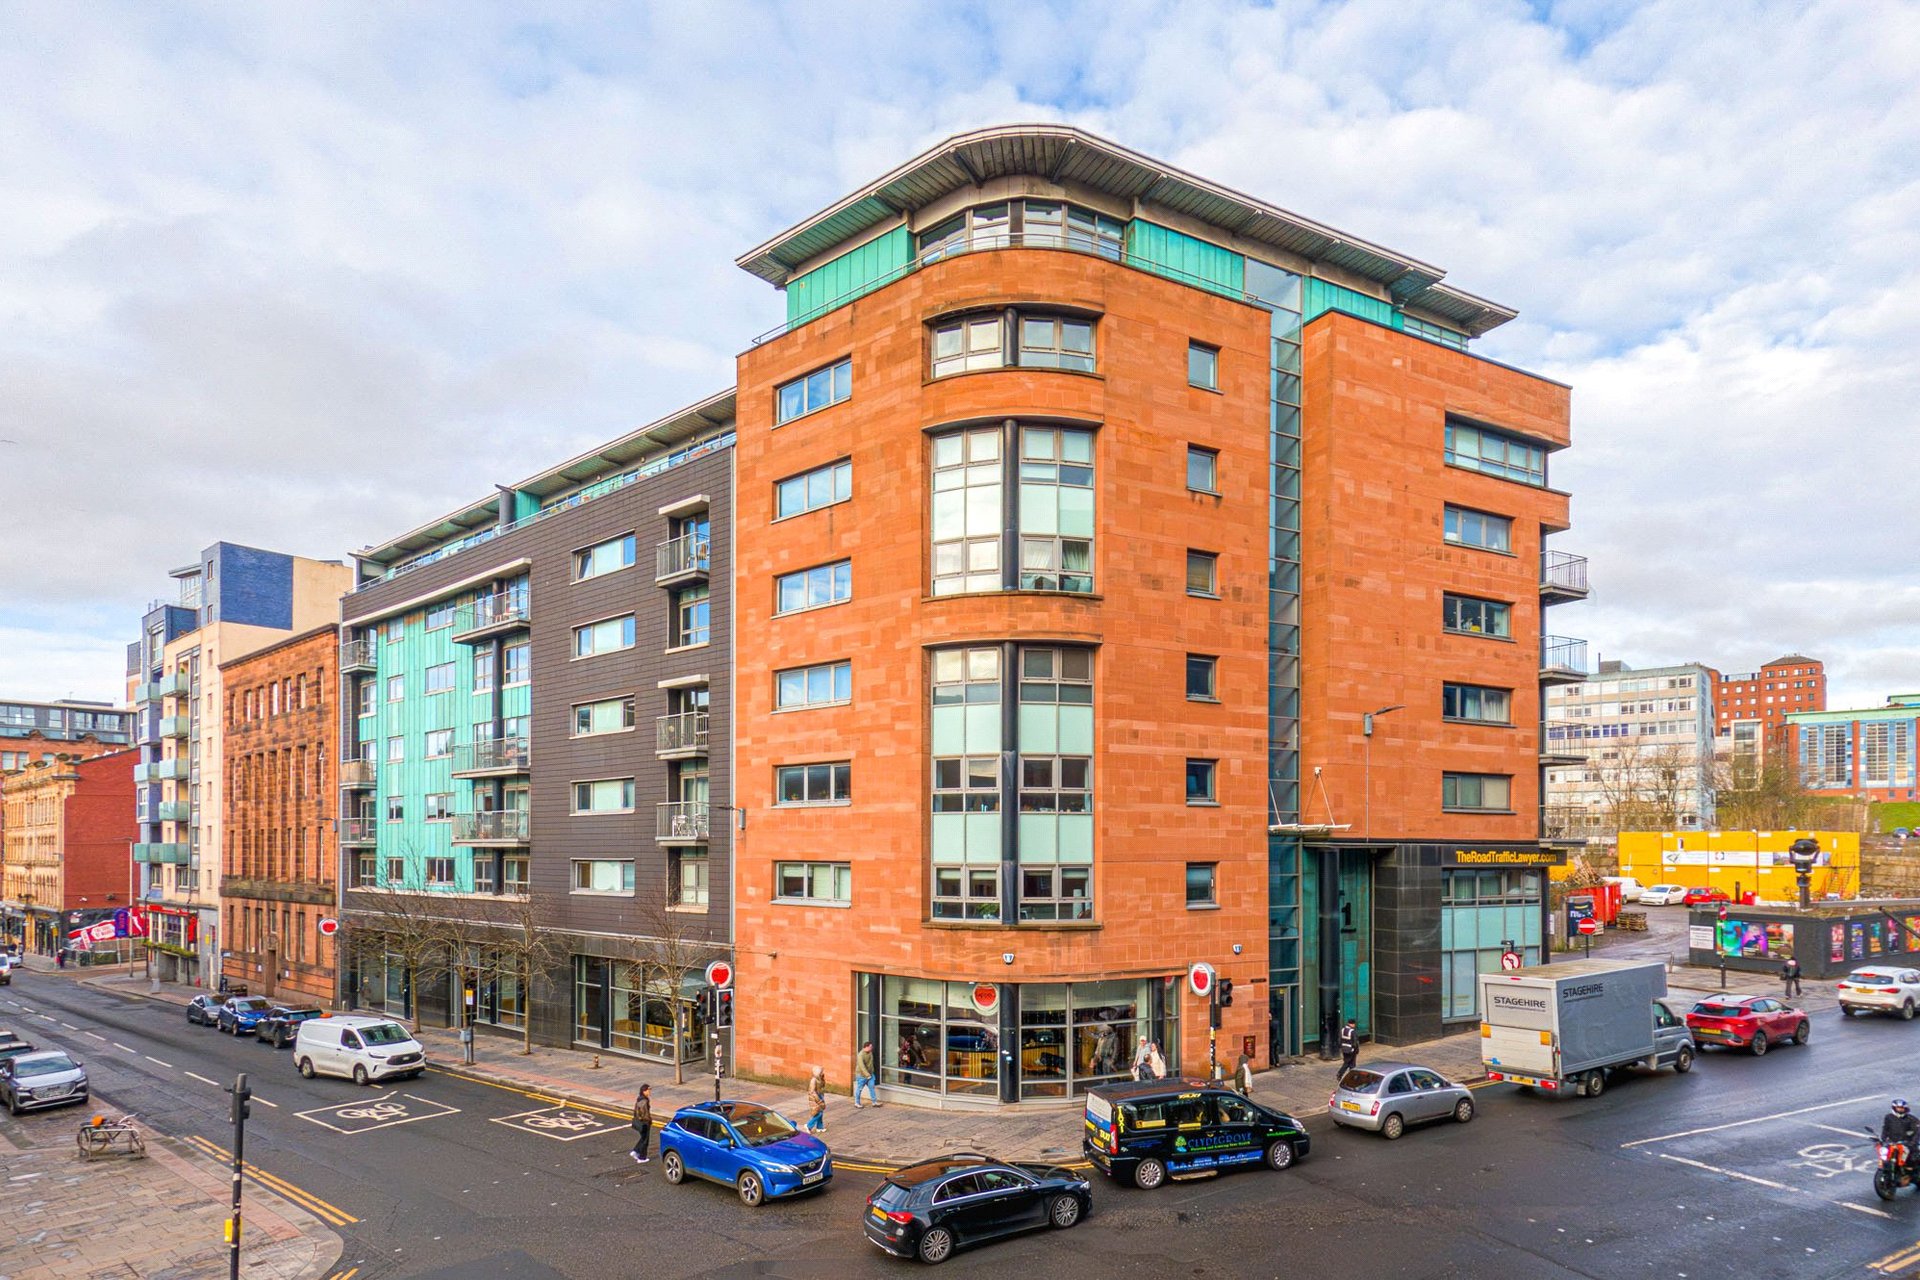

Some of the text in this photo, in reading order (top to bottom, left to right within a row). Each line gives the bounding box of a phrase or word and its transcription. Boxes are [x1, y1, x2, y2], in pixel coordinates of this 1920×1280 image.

[1456, 850, 1557, 866] TheRoadTrafficLawyer.com
[1563, 983, 1604, 998] STAGEHIRE
[1494, 996, 1546, 1009] STAGEHIRE
